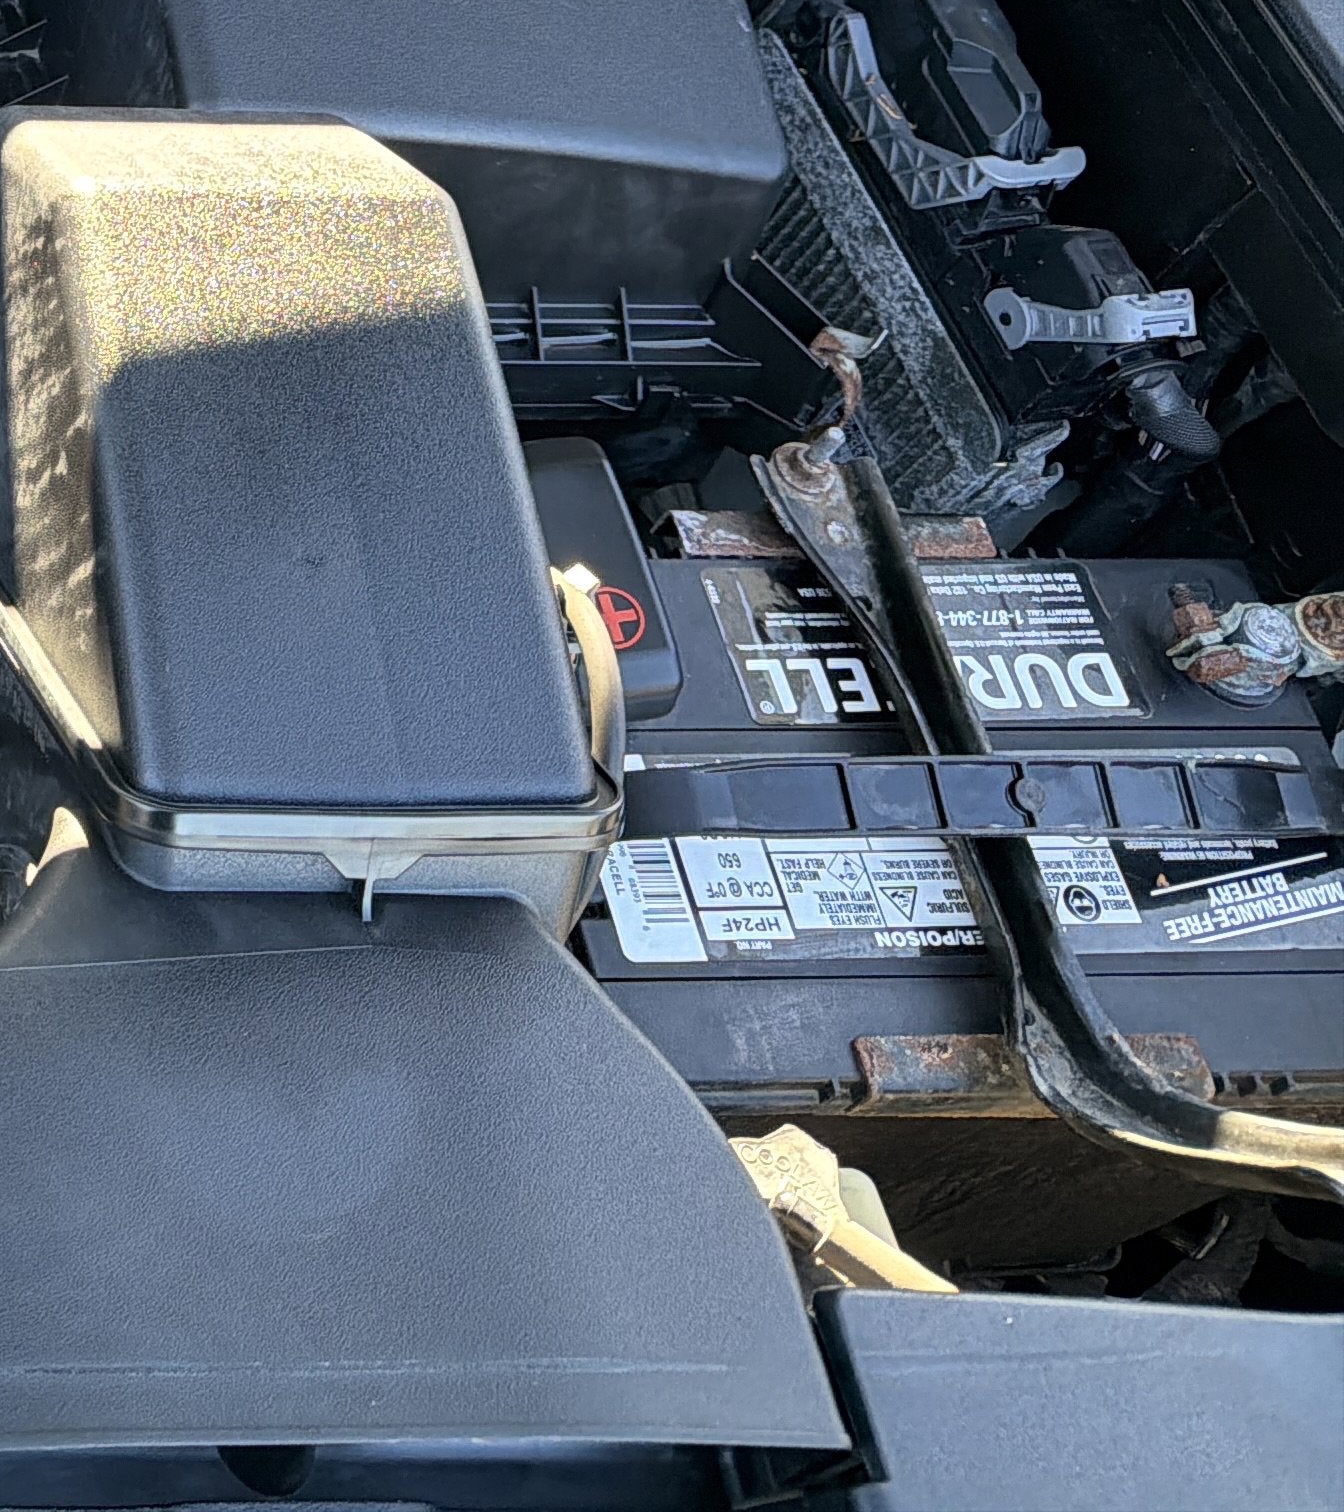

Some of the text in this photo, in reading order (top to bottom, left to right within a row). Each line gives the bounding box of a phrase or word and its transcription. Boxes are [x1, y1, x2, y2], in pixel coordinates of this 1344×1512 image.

[717, 852, 742, 869] 650
[804, 859, 827, 870] HELP
[780, 871, 821, 881] MEDICAL
[871, 871, 914, 882] BLINDNESS
[1044, 871, 1121, 883] EXPLOSIVE GASES
[743, 881, 774, 898] CCA
[786, 882, 804, 893] GET
[1207, 871, 1290, 908] BATTERY
[848, 891, 874, 902] WITH
[943, 888, 966, 901] ACID
[818, 903, 878, 915] IMMEDIATELY
[927, 902, 971, 914] SULFURIC
[1102, 899, 1132, 910] SHIELD
[1163, 880, 1344, 941] MAINTENANCE-FREE
[721, 917, 782, 933] HP24F
[828, 915, 882, 927] FLUSH EYES
[753, 940, 773, 950] PART
